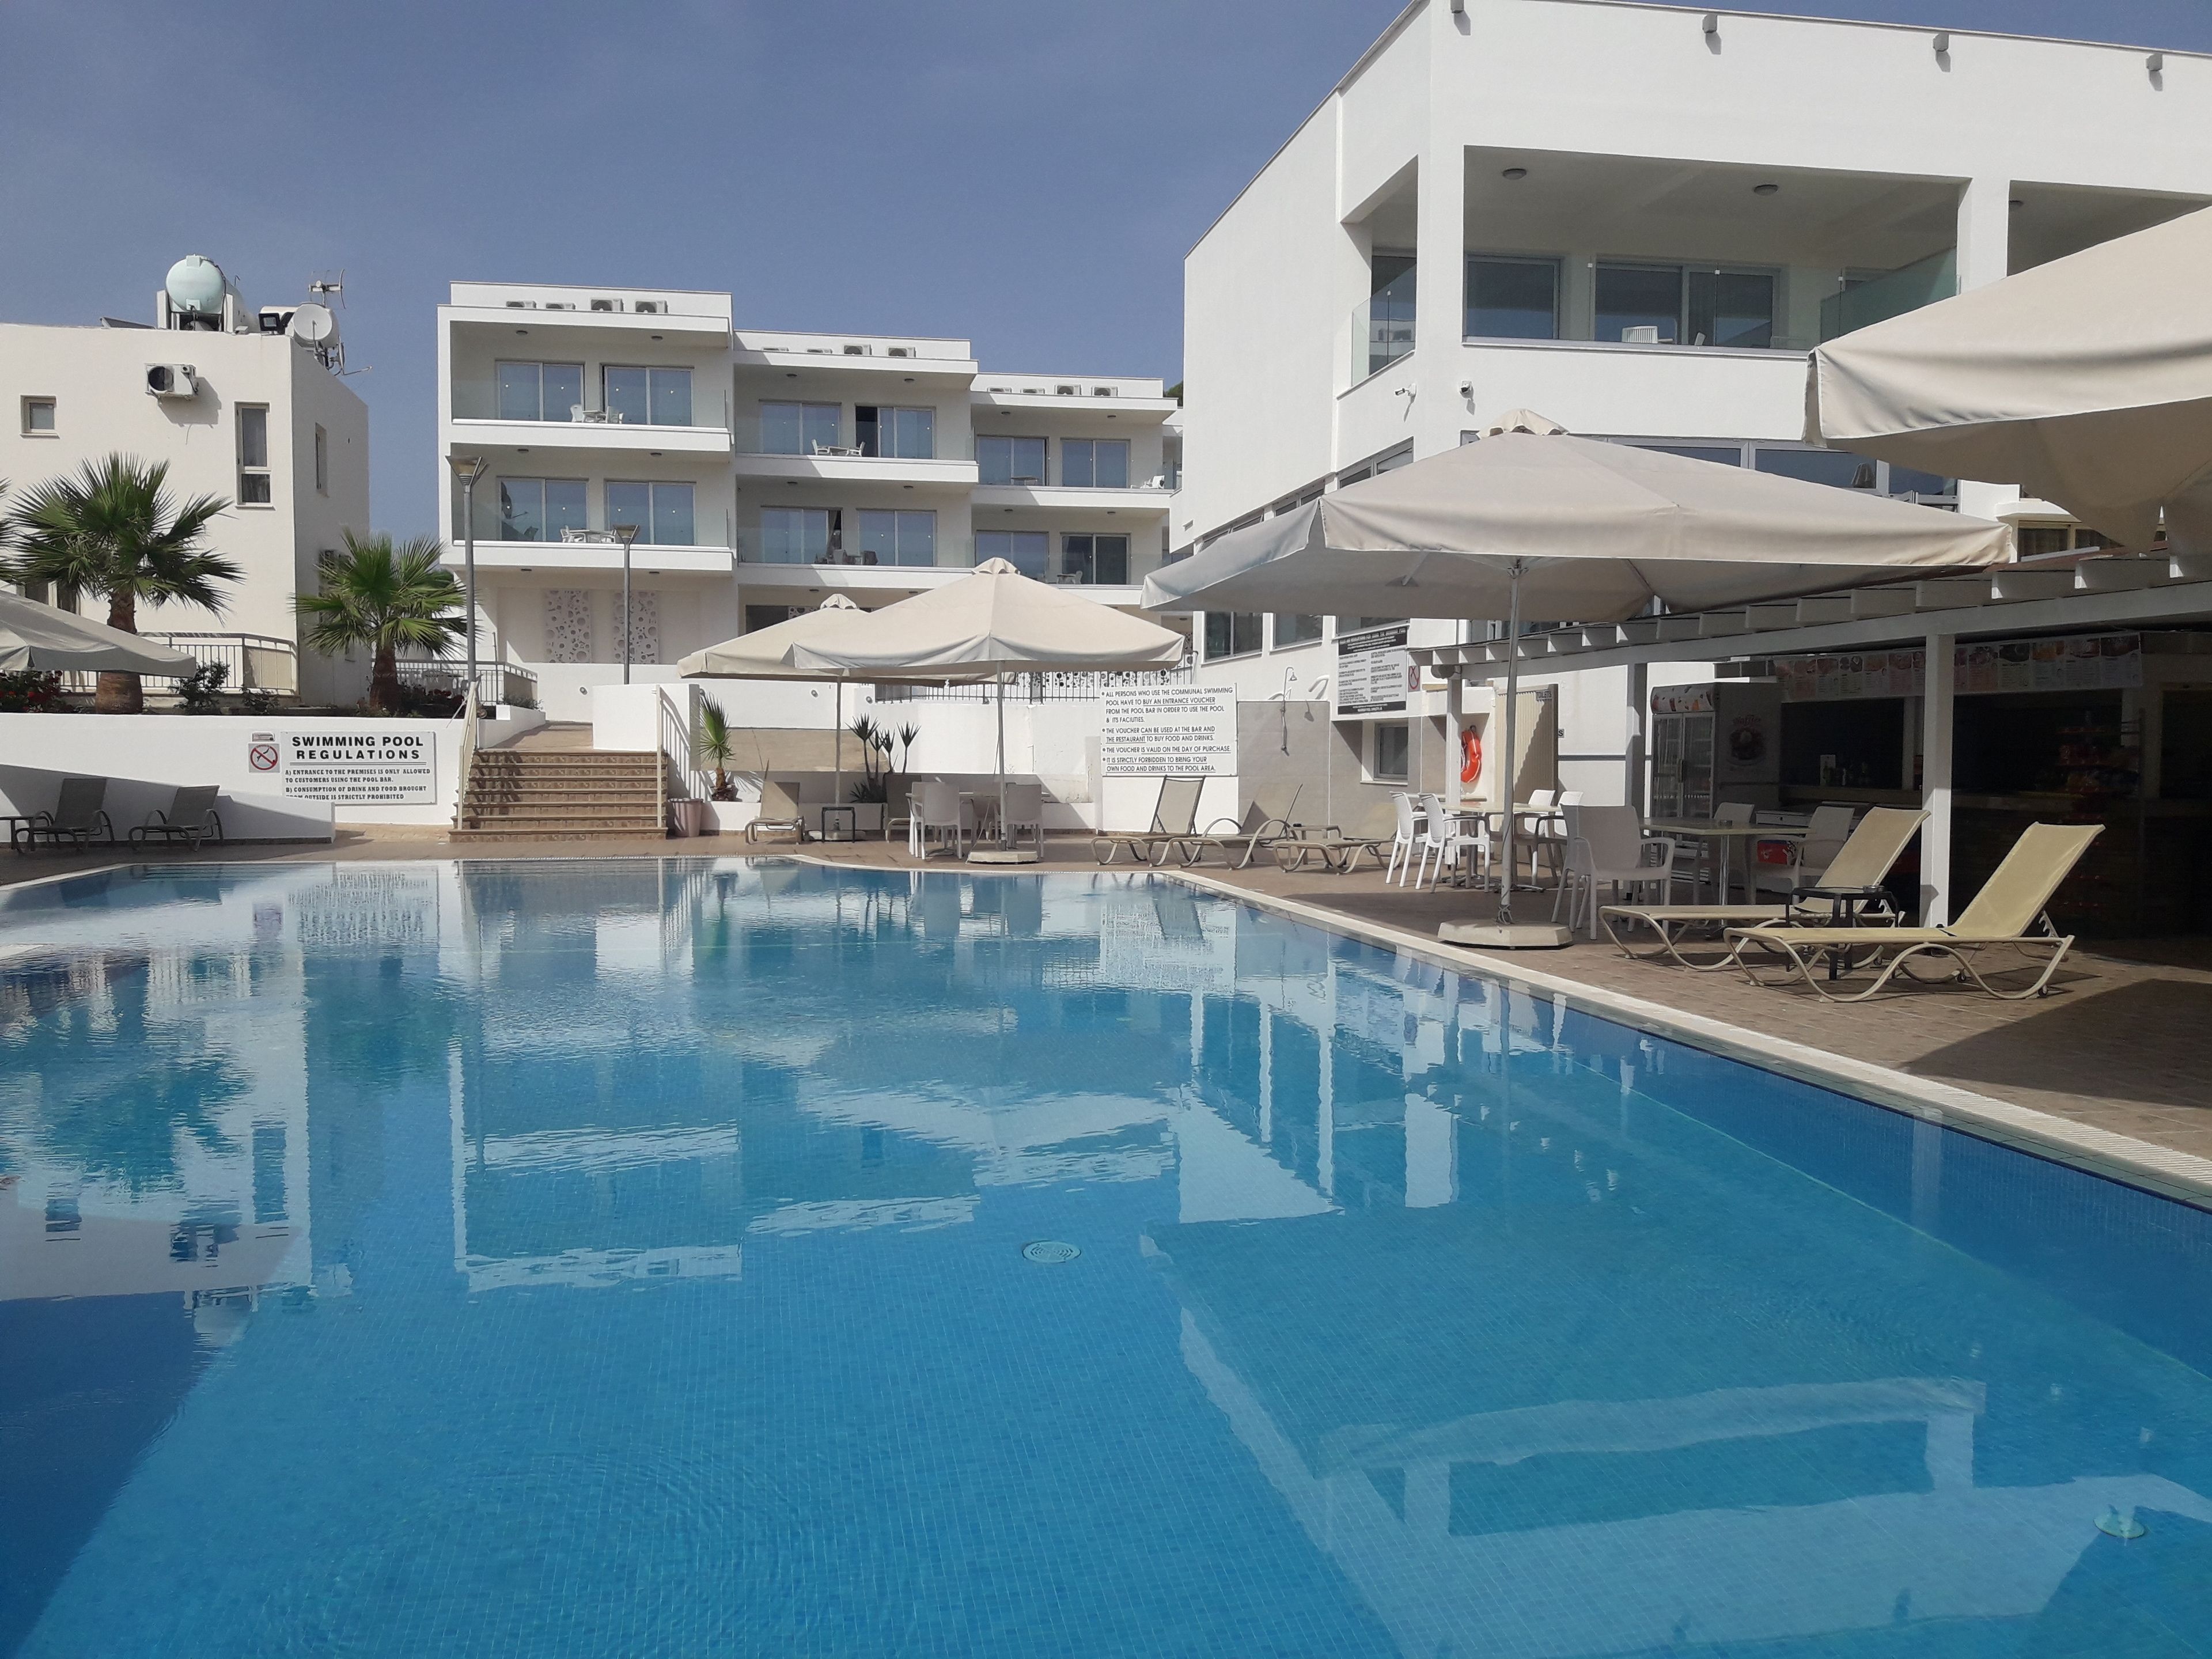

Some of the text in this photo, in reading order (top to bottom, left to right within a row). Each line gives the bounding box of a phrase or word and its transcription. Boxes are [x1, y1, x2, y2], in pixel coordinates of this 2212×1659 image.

[292, 736, 423, 747] SWIMMING POOL
[297, 750, 419, 759] REGULATIONS
